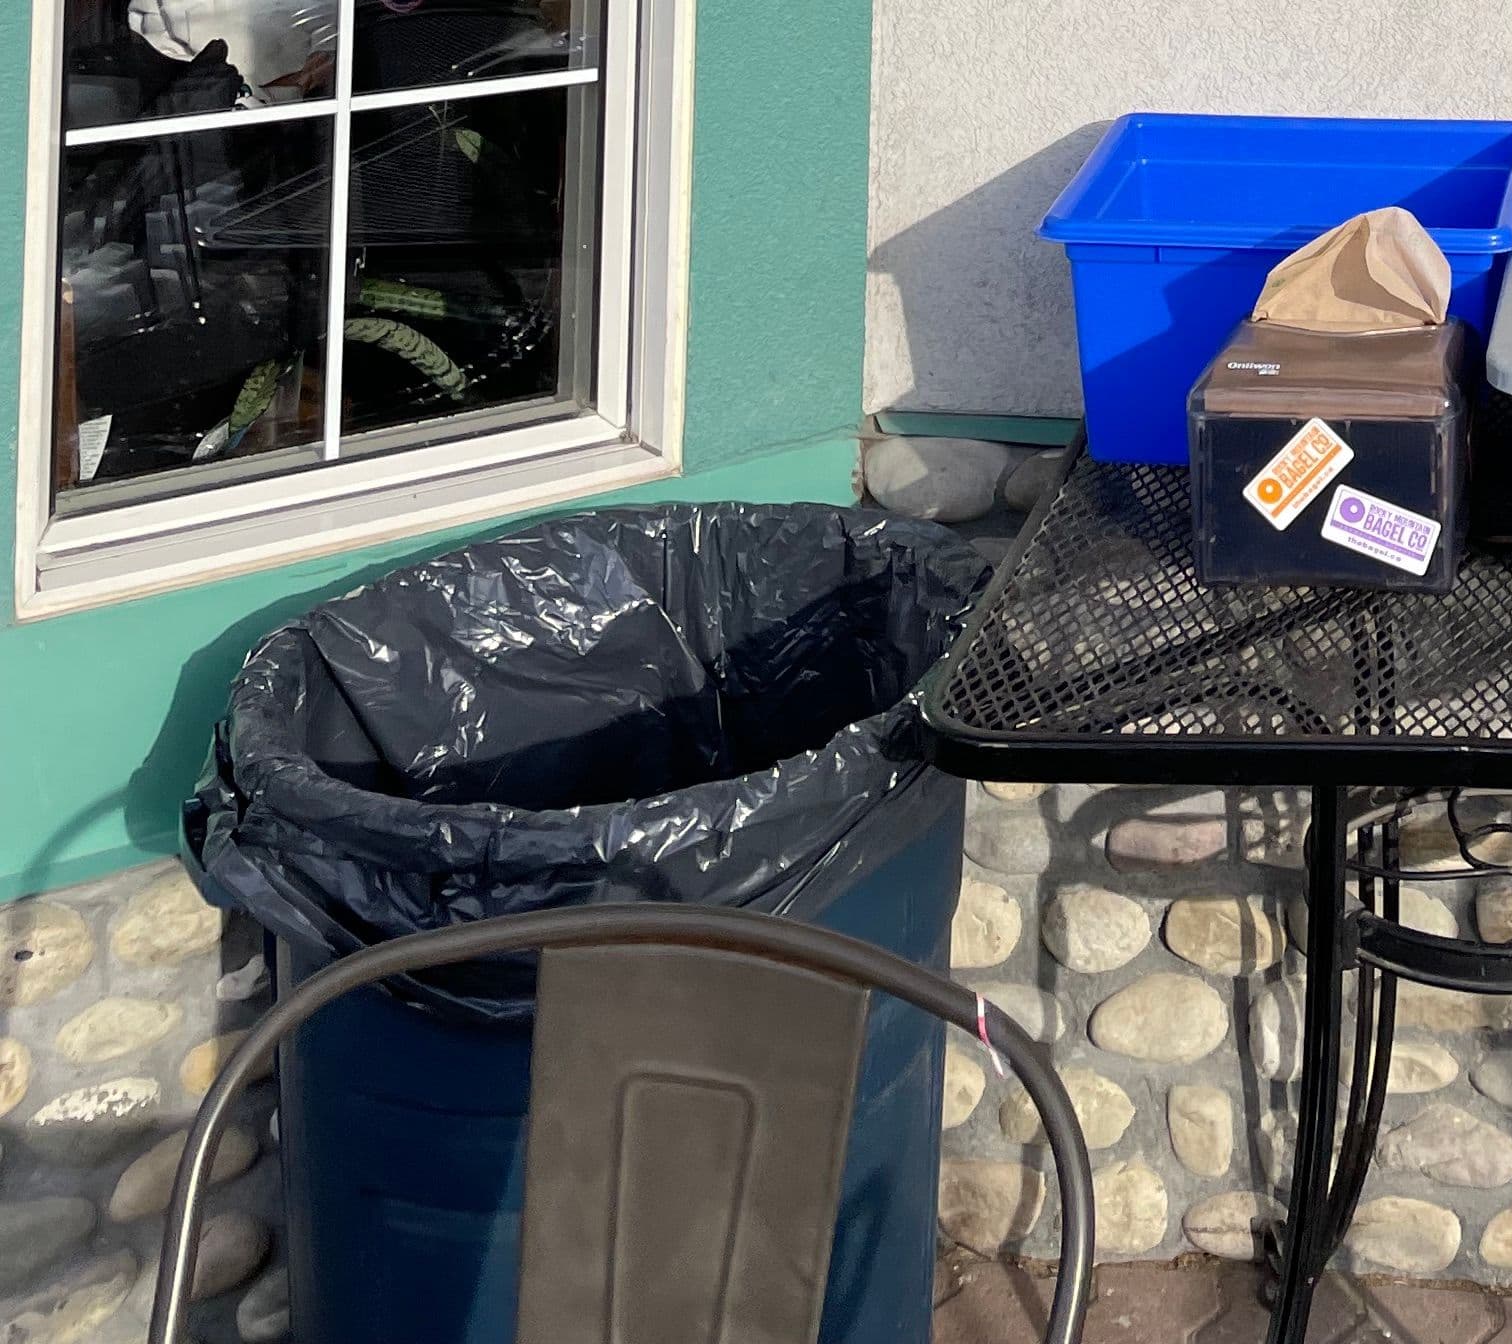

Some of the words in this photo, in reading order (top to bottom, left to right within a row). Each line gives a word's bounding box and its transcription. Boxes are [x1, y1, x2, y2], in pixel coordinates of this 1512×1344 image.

[1278, 450, 1319, 488] BAGEL
[1311, 433, 1333, 455] CO
[1363, 514, 1406, 545] BAGEL
[1407, 531, 1428, 552] CO
